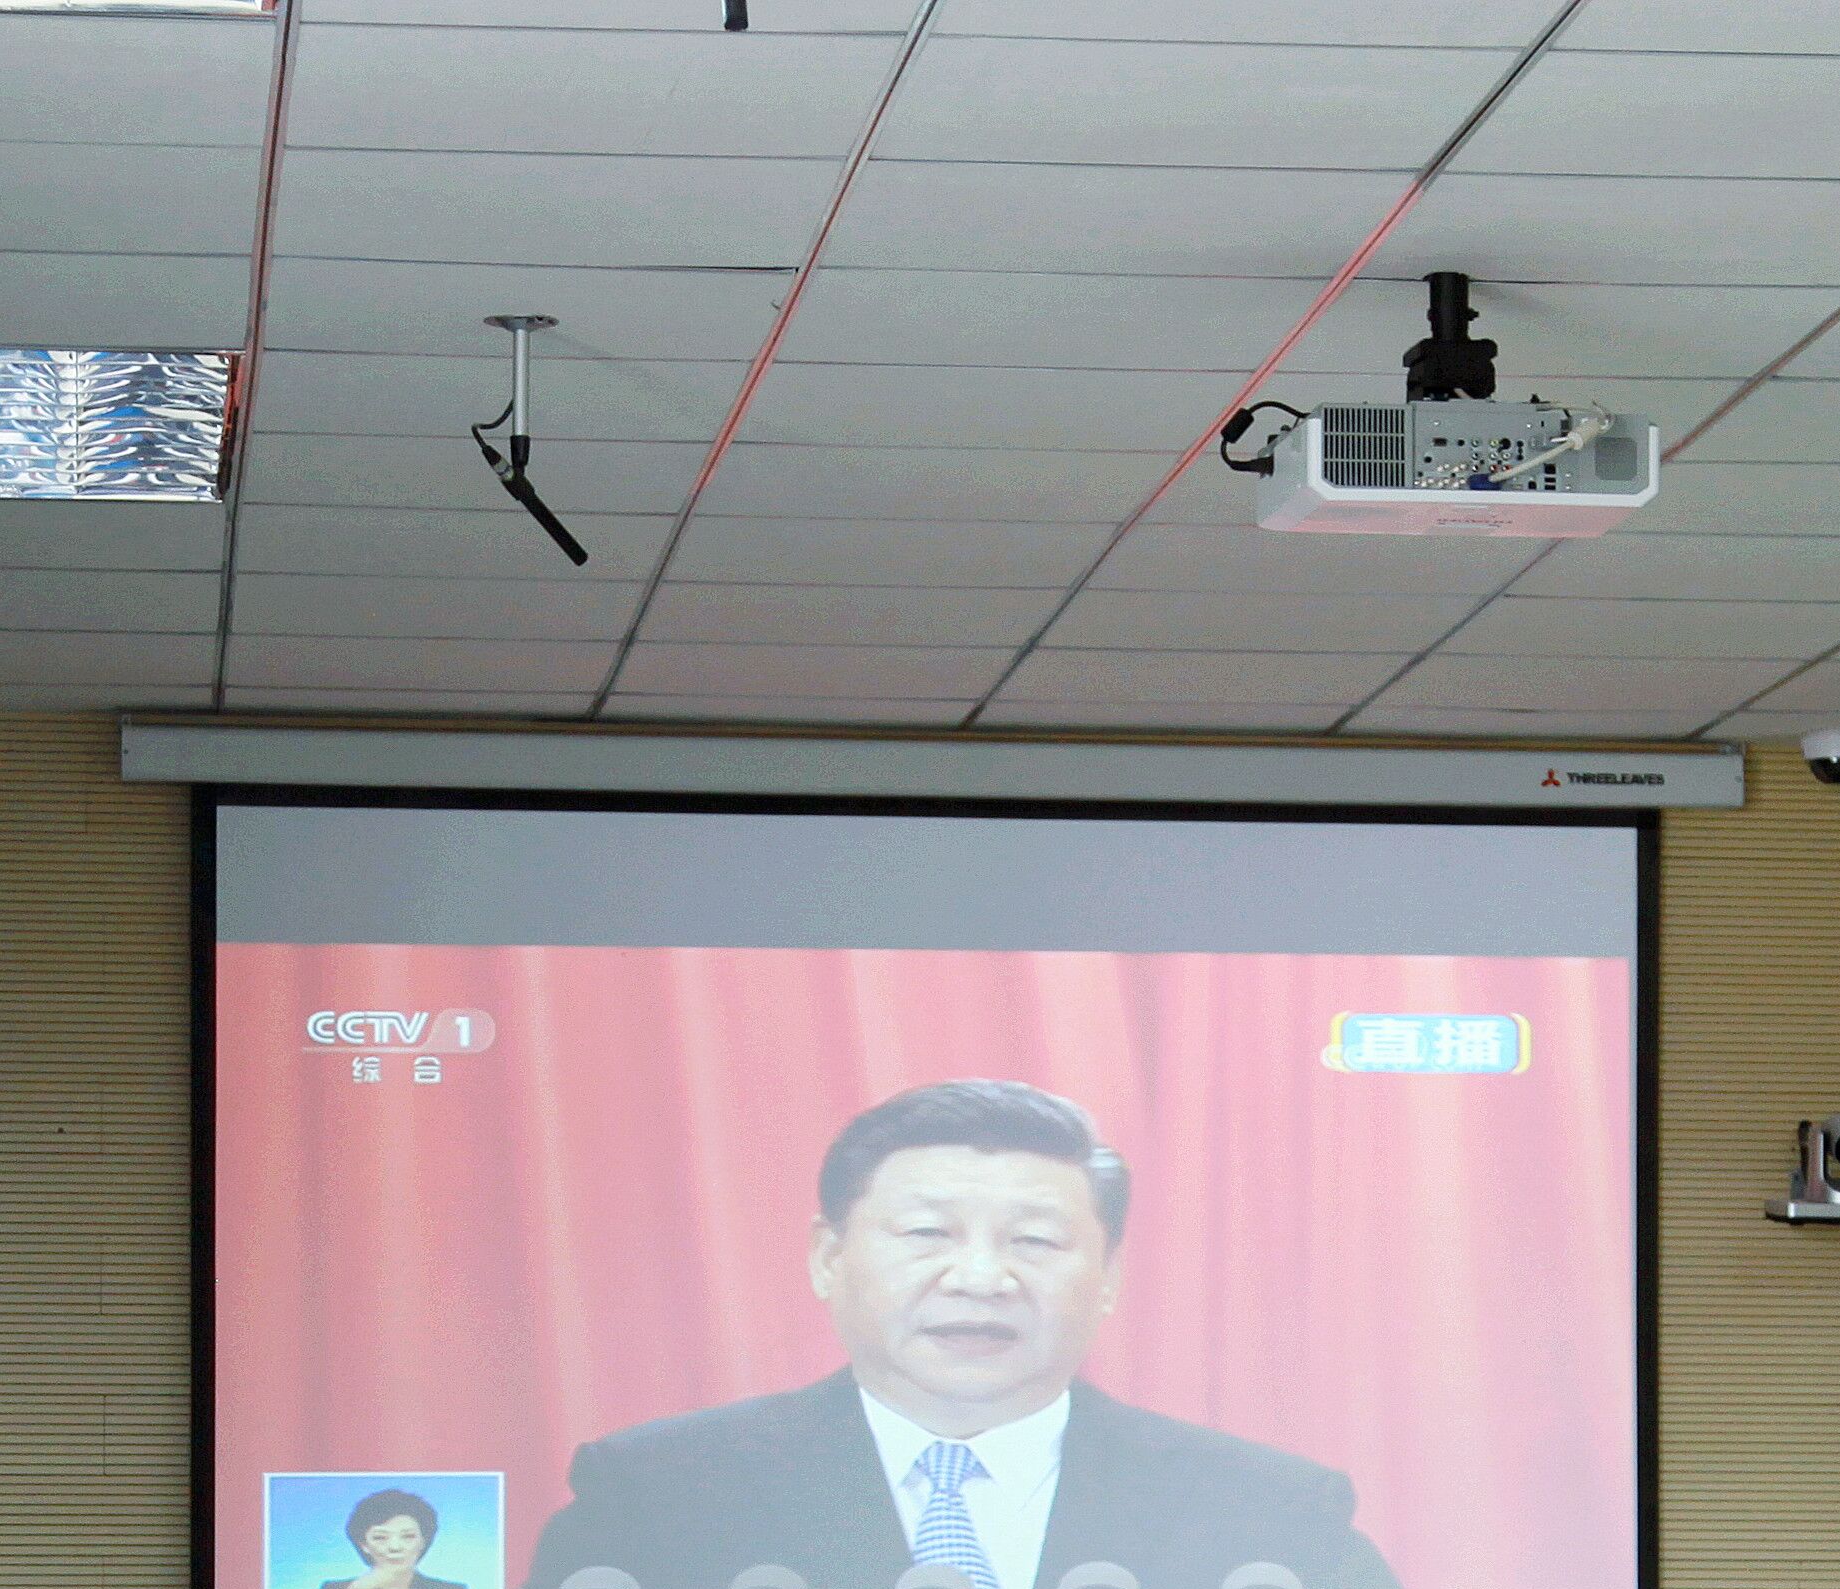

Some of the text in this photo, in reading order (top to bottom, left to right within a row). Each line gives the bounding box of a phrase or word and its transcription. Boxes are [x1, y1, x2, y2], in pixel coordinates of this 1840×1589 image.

[306, 1010, 471, 1048] CCTV 1
[1358, 1018, 1502, 1065] 直播
[352, 1056, 443, 1083] 综合
